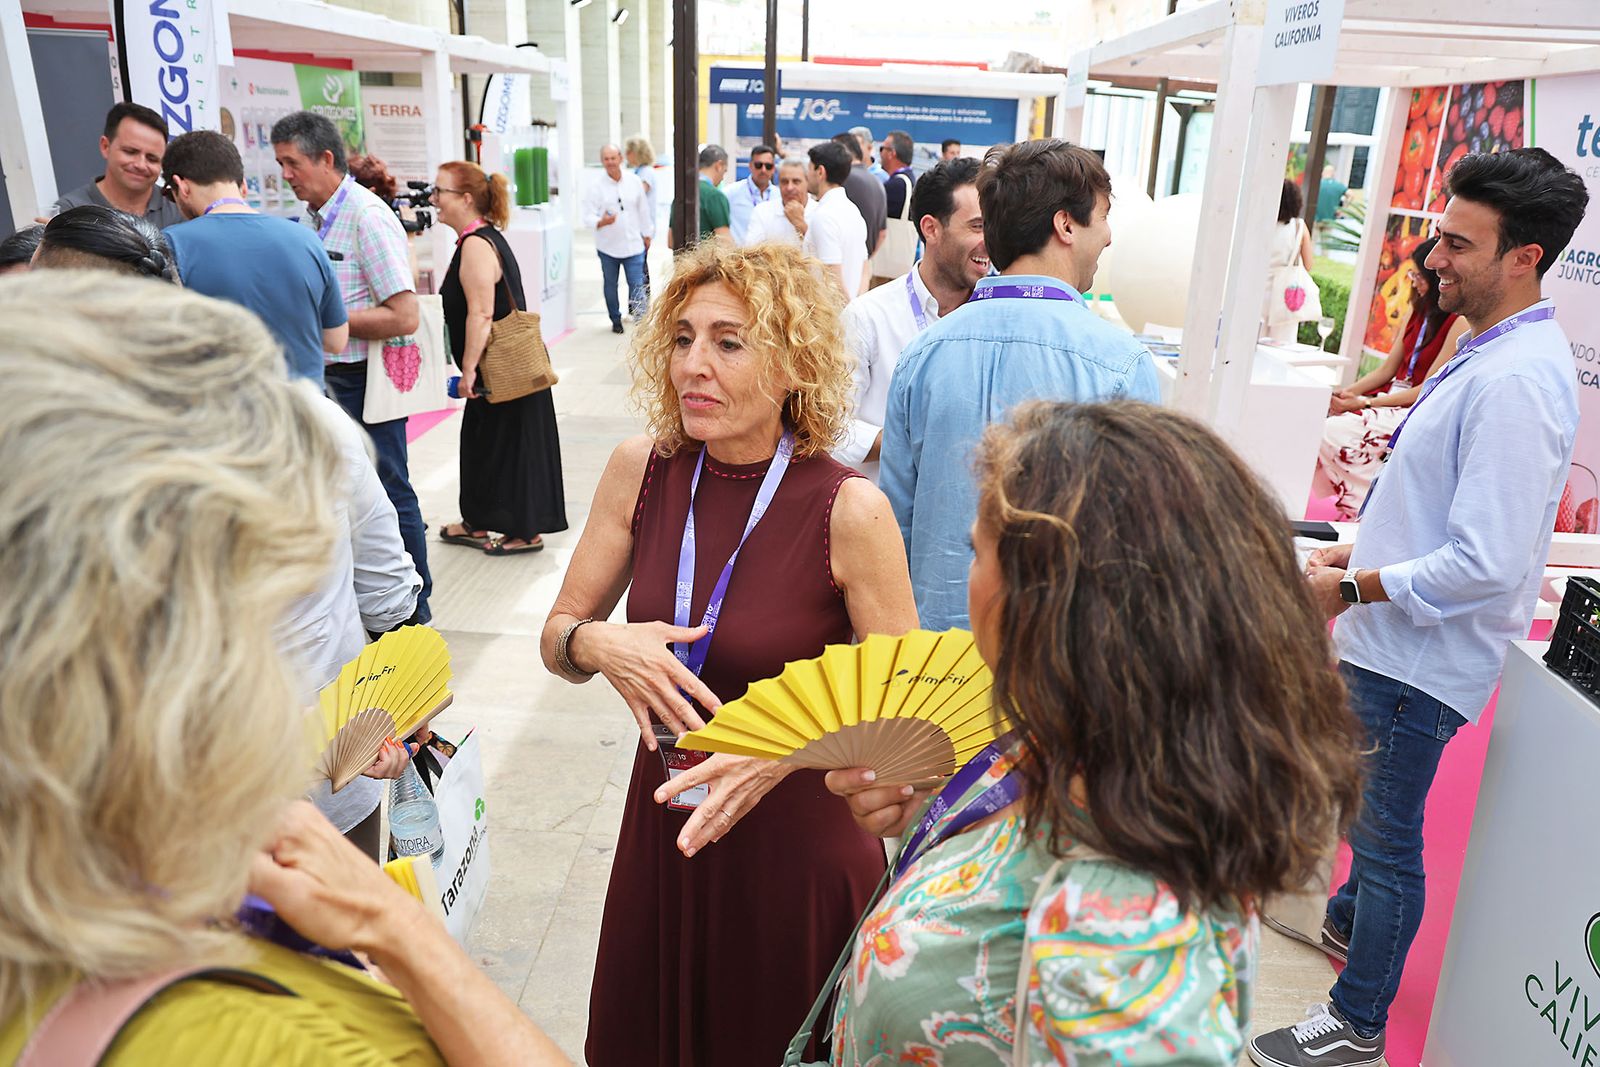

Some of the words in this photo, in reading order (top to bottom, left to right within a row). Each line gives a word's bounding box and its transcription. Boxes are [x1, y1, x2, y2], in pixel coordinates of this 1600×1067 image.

[1285, 0, 1320, 23] VIVEROS
[1275, 24, 1321, 48] CALIFORNIA
[149, 0, 193, 143] ZGO
[369, 104, 421, 116] TERRA
[1576, 367, 1600, 389] ICA
[441, 825, 477, 917] Tarazona
